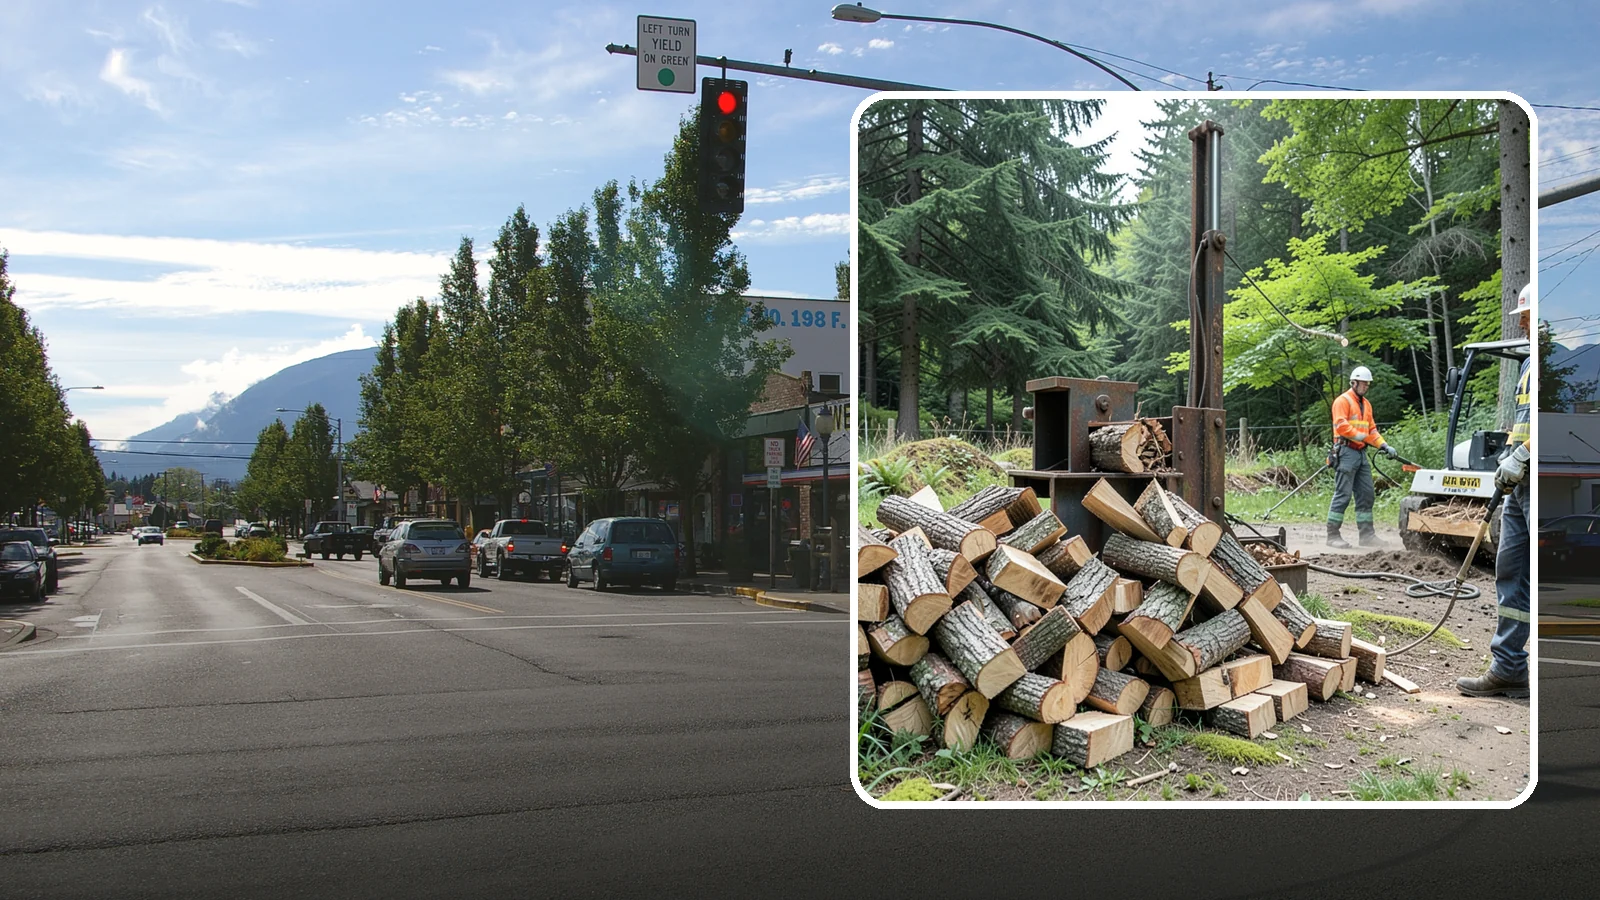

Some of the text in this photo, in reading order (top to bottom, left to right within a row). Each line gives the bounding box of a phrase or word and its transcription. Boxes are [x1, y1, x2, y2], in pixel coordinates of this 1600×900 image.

[643, 24, 690, 36] LEFT TURN
[652, 38, 682, 51] YIELD
[644, 53, 688, 66] ON GREEN
[791, 309, 826, 328] 198
[831, 311, 846, 329] F.
